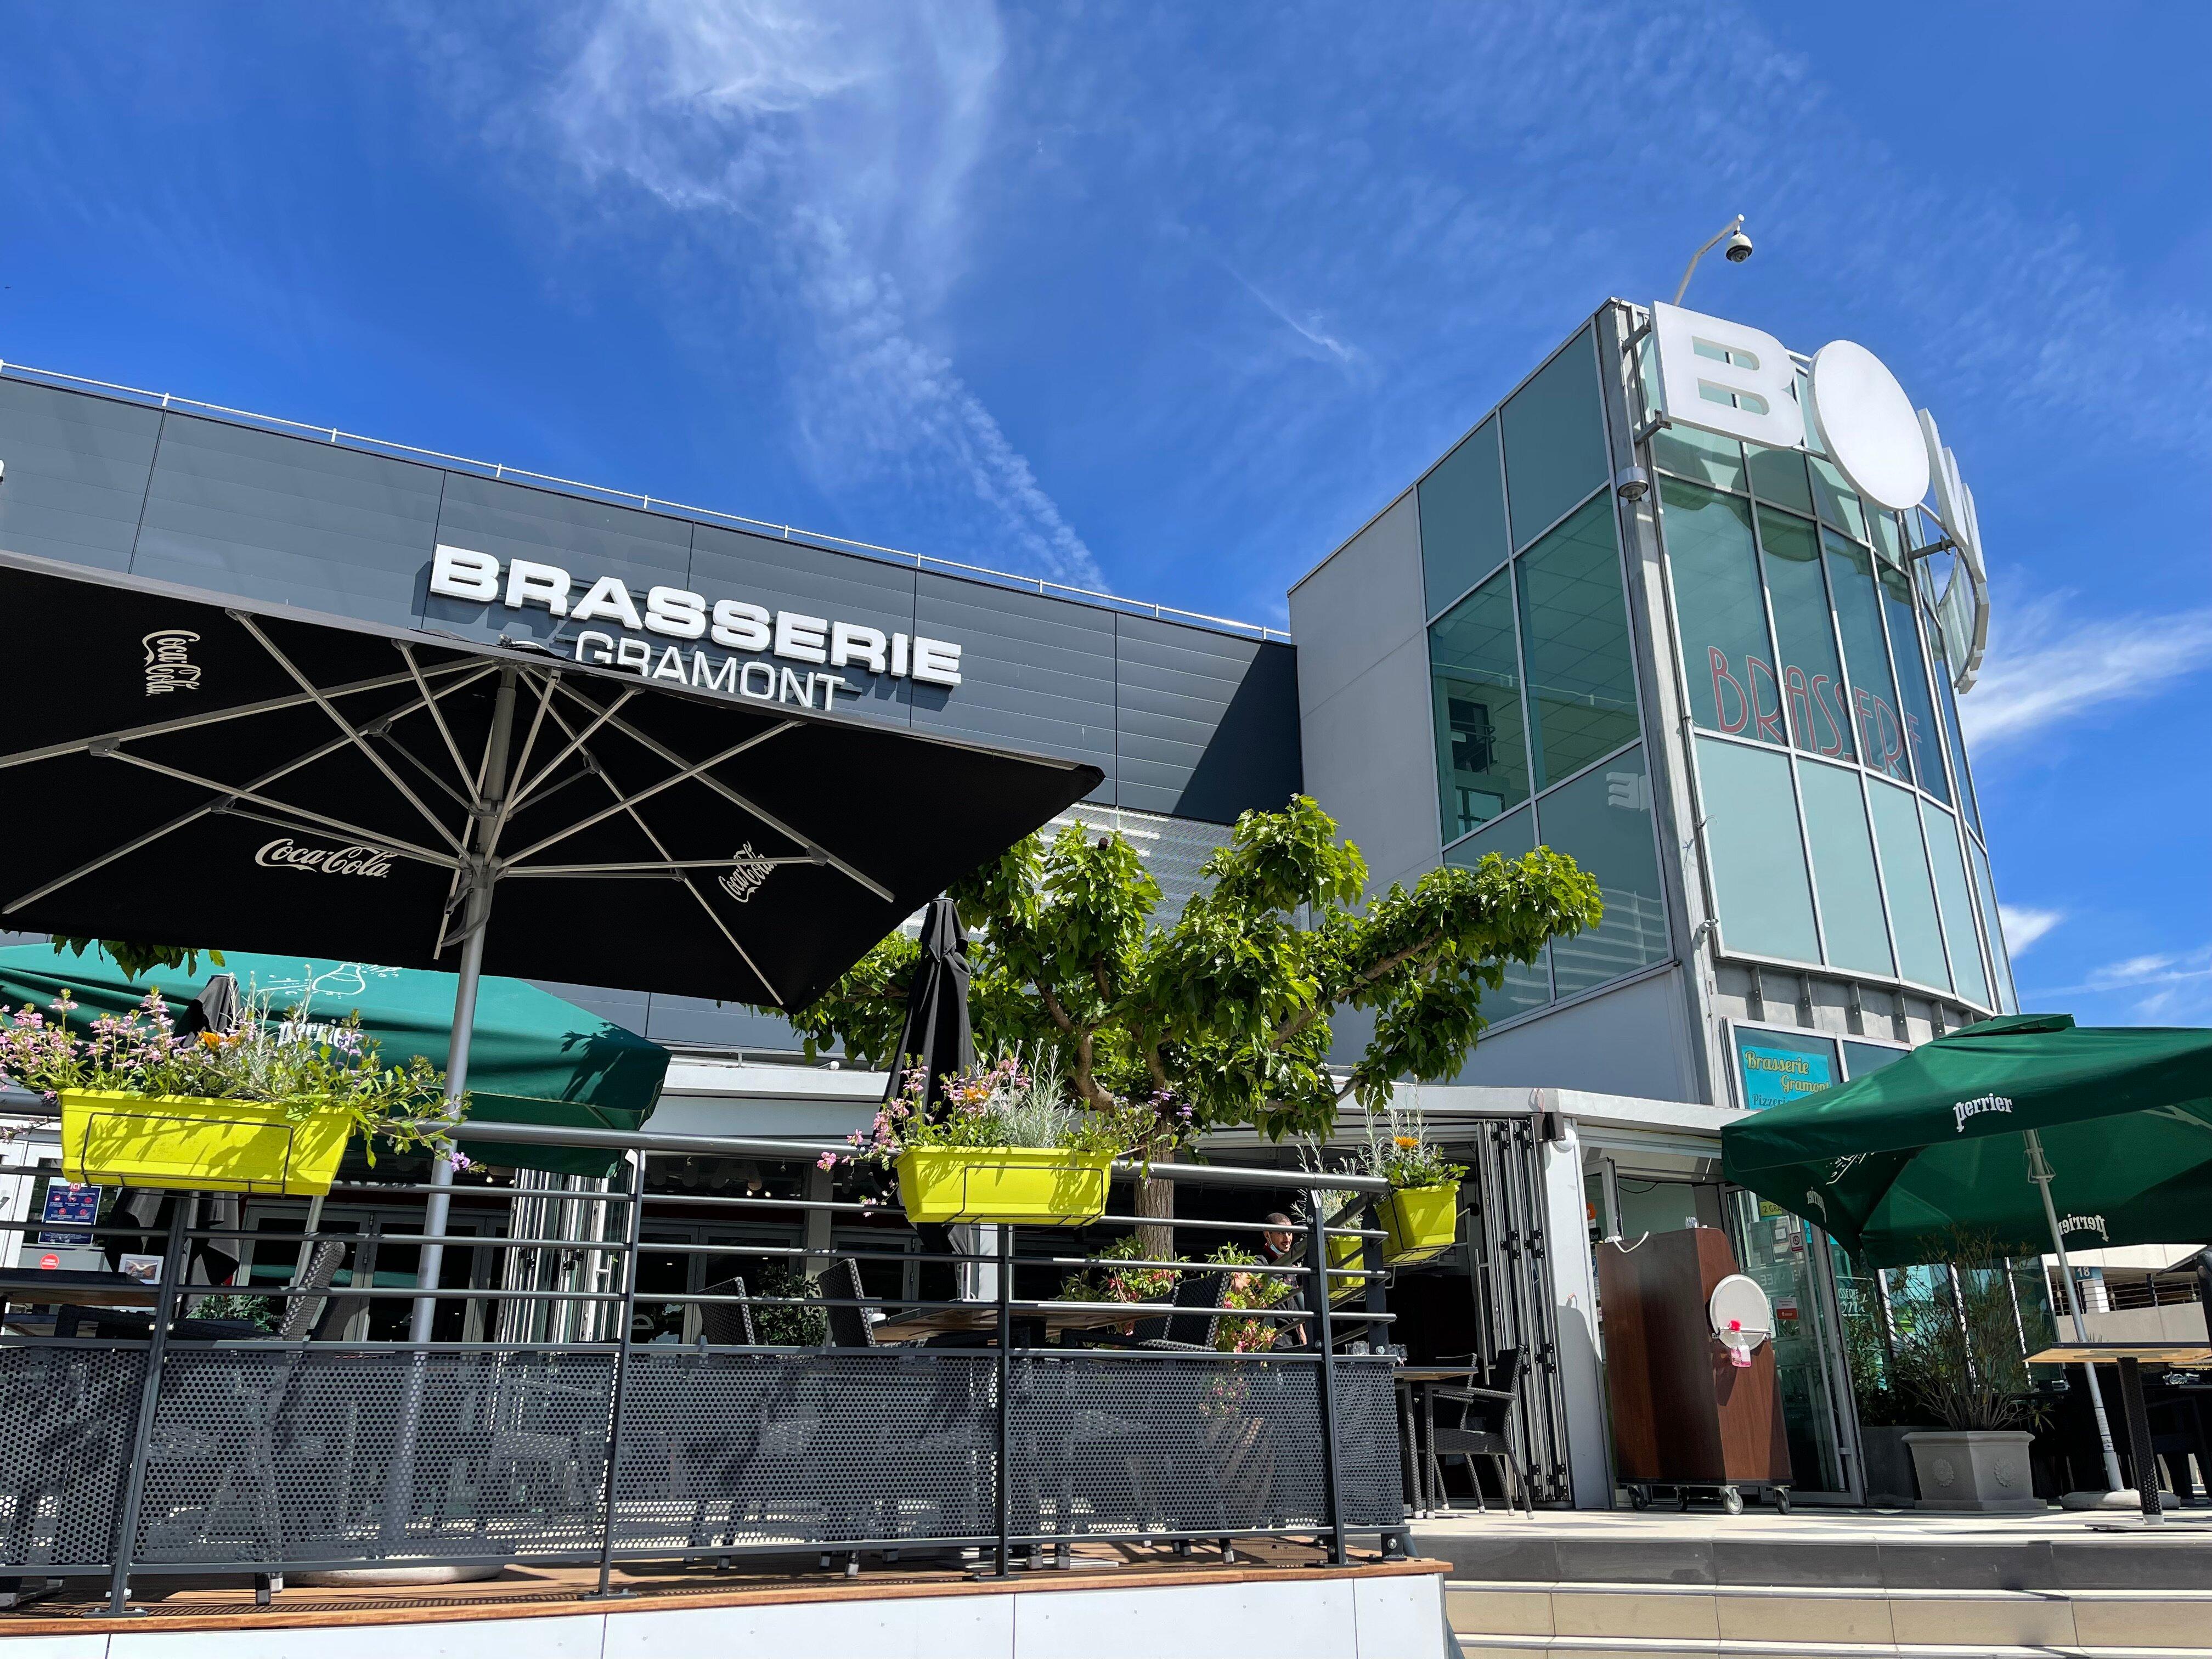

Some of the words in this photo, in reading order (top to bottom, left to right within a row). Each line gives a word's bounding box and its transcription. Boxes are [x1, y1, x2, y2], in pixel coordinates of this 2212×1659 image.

[430, 543, 962, 686] BRASSERIE
[142, 630, 201, 696] Coca-Cola
[575, 630, 845, 712] GRAMONT
[1707, 645, 1932, 796] BRASERE
[255, 838, 398, 878] Coca-Cola
[1745, 1050, 1809, 1075] Brasserie
[1752, 1094, 1791, 1107] Pizzeri
[2077, 1267, 2090, 1277] 18
